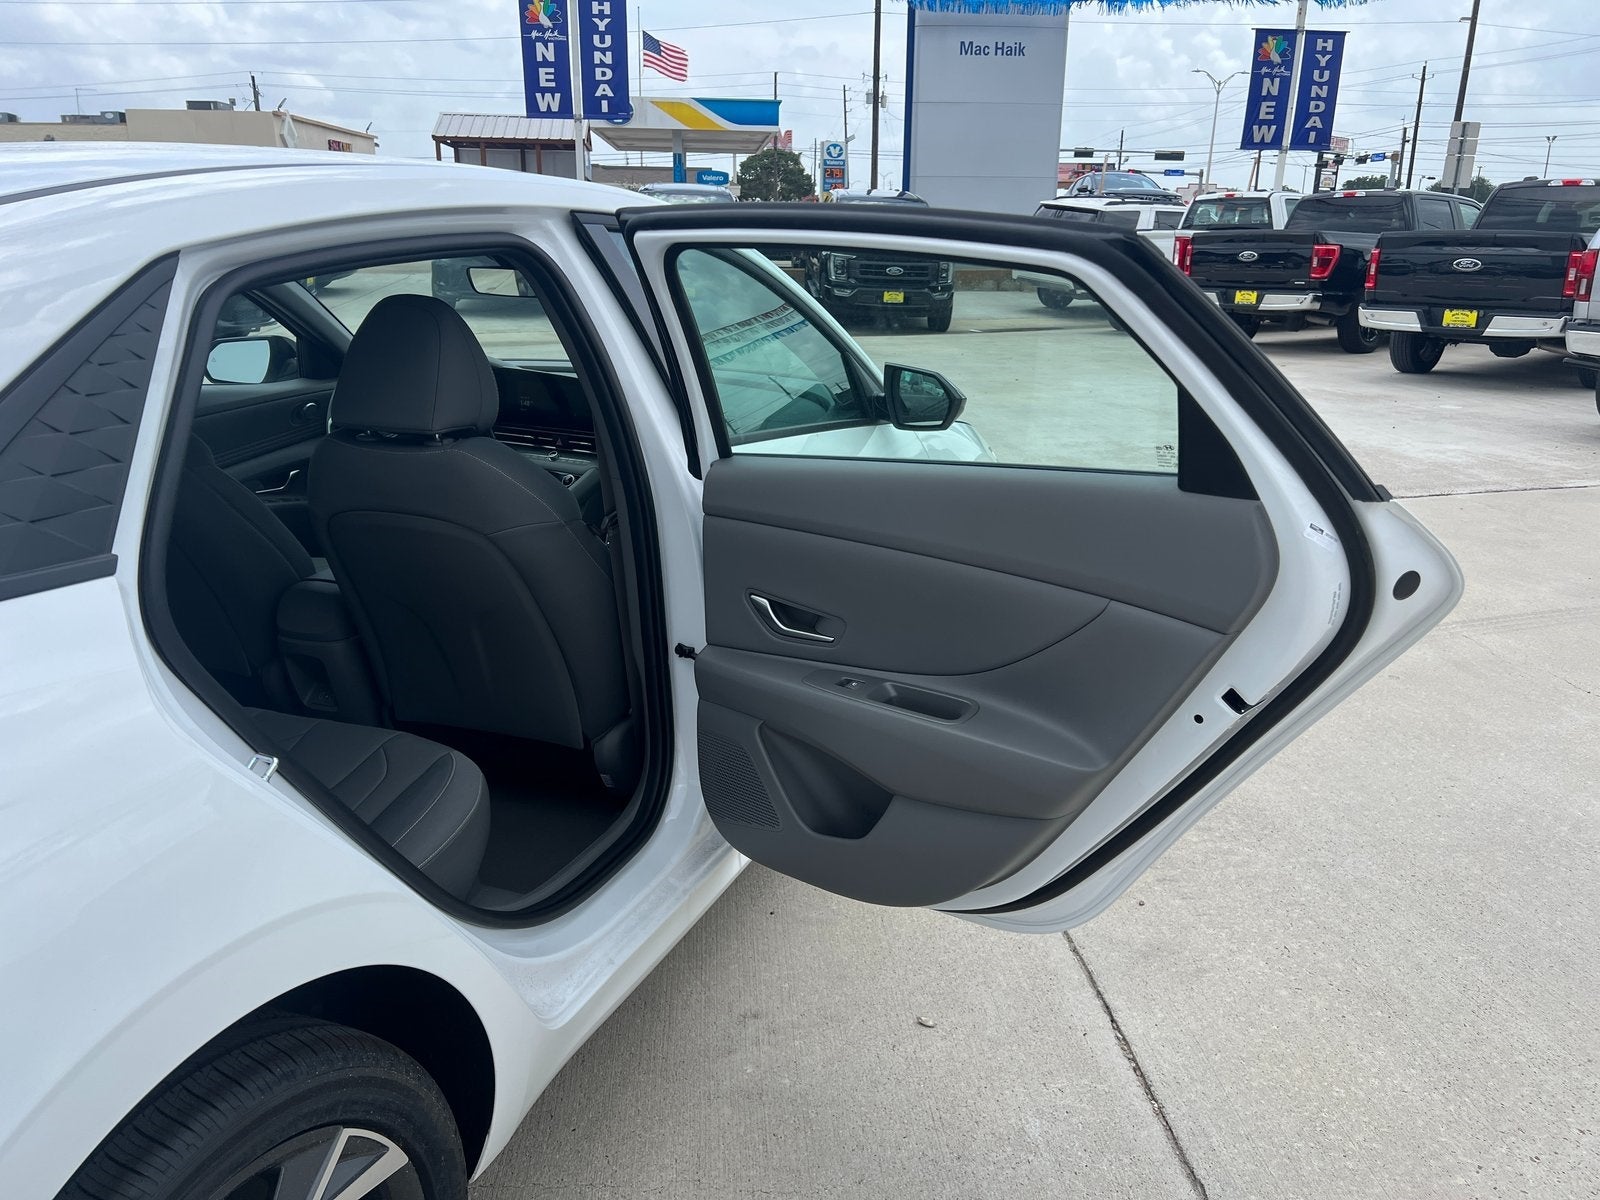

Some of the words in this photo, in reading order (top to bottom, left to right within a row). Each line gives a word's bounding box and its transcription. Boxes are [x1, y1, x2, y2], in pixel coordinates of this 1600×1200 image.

[535, 42, 561, 112] NEW
[591, 1, 615, 113] HYUNDAI
[960, 41, 990, 56] Mac
[994, 41, 1026, 57] Haik
[1252, 77, 1280, 143] NEW
[1304, 38, 1334, 144] HYUNDAI
[702, 174, 724, 182] Valero
